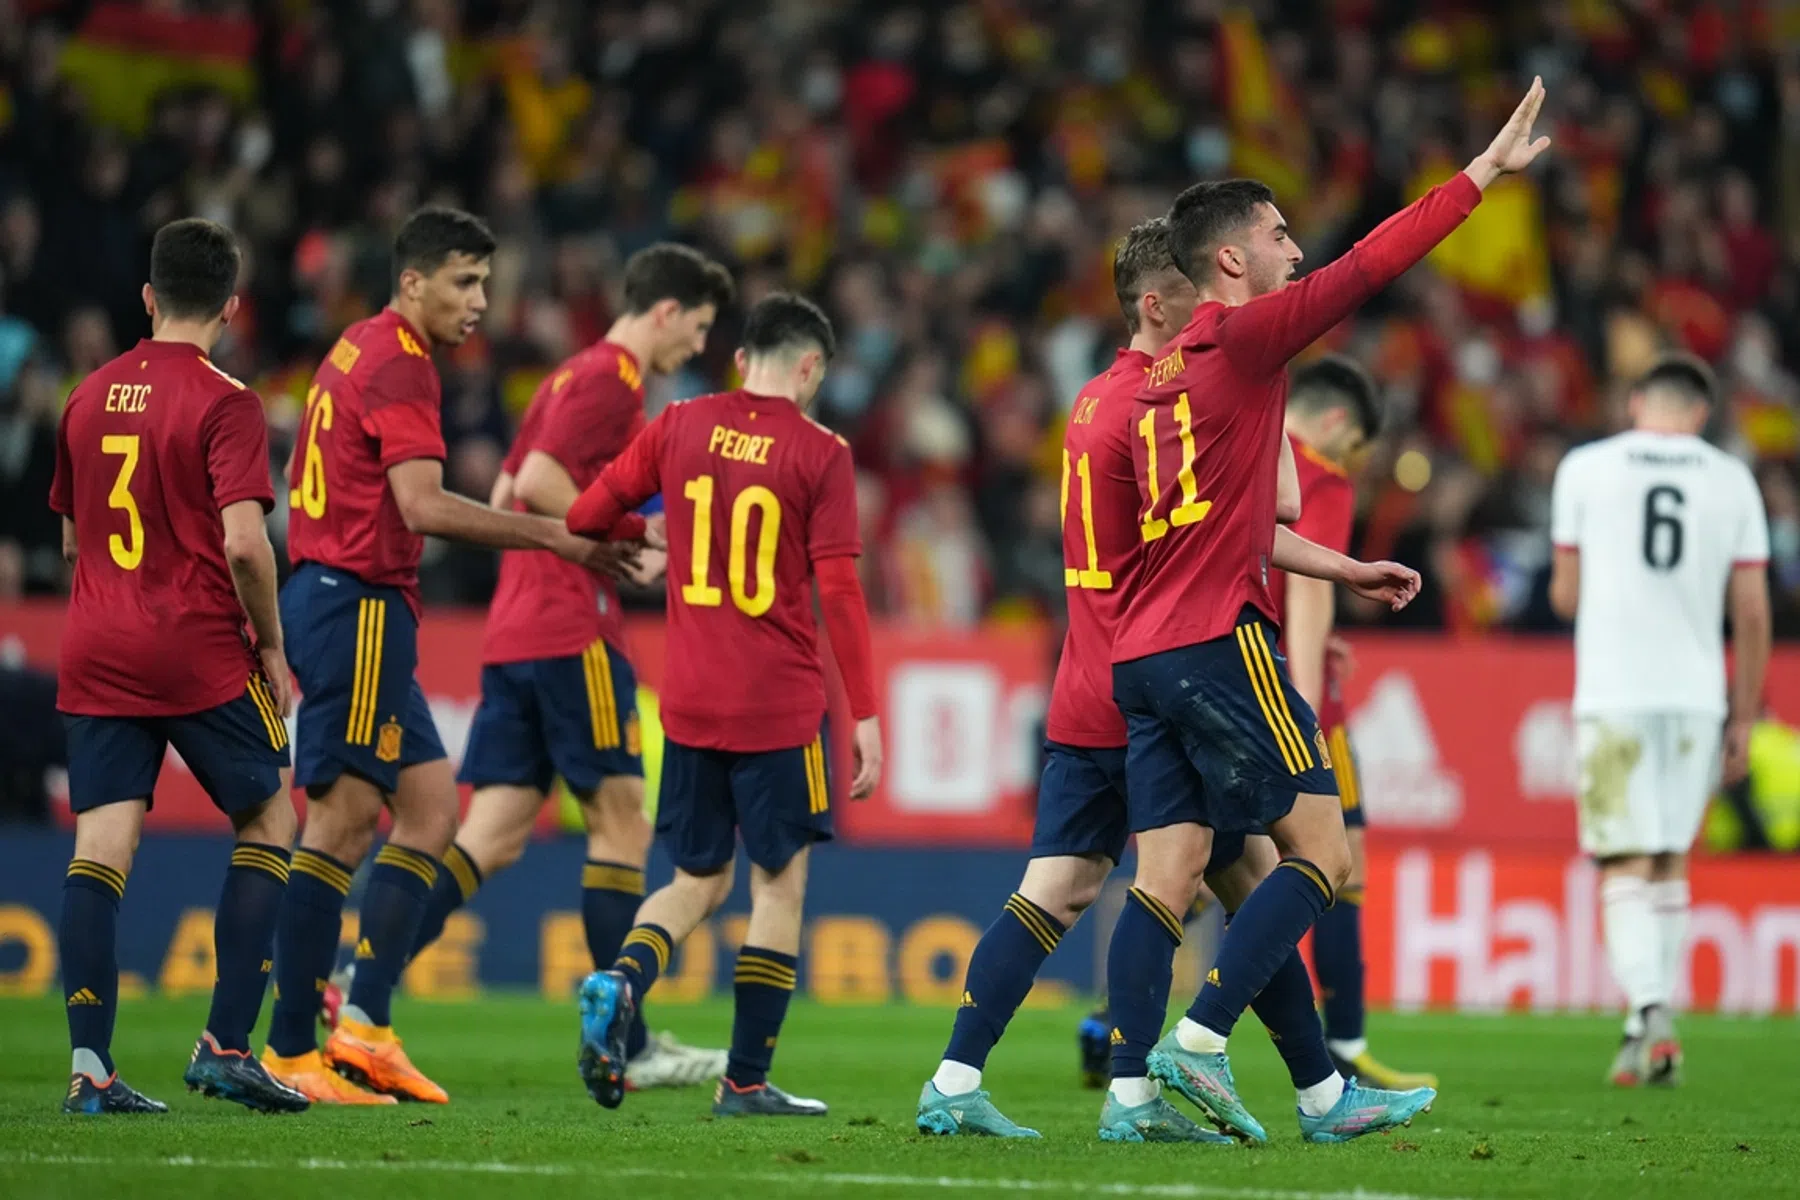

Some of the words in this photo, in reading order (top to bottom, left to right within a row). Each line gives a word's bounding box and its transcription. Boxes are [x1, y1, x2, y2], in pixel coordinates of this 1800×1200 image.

[104, 383, 152, 413] ERIC
[708, 424, 775, 465] PEDRI
[101, 434, 145, 571] 3
[1137, 391, 1213, 543] 11
[682, 474, 781, 618] 10
[1643, 484, 1686, 574] 6
